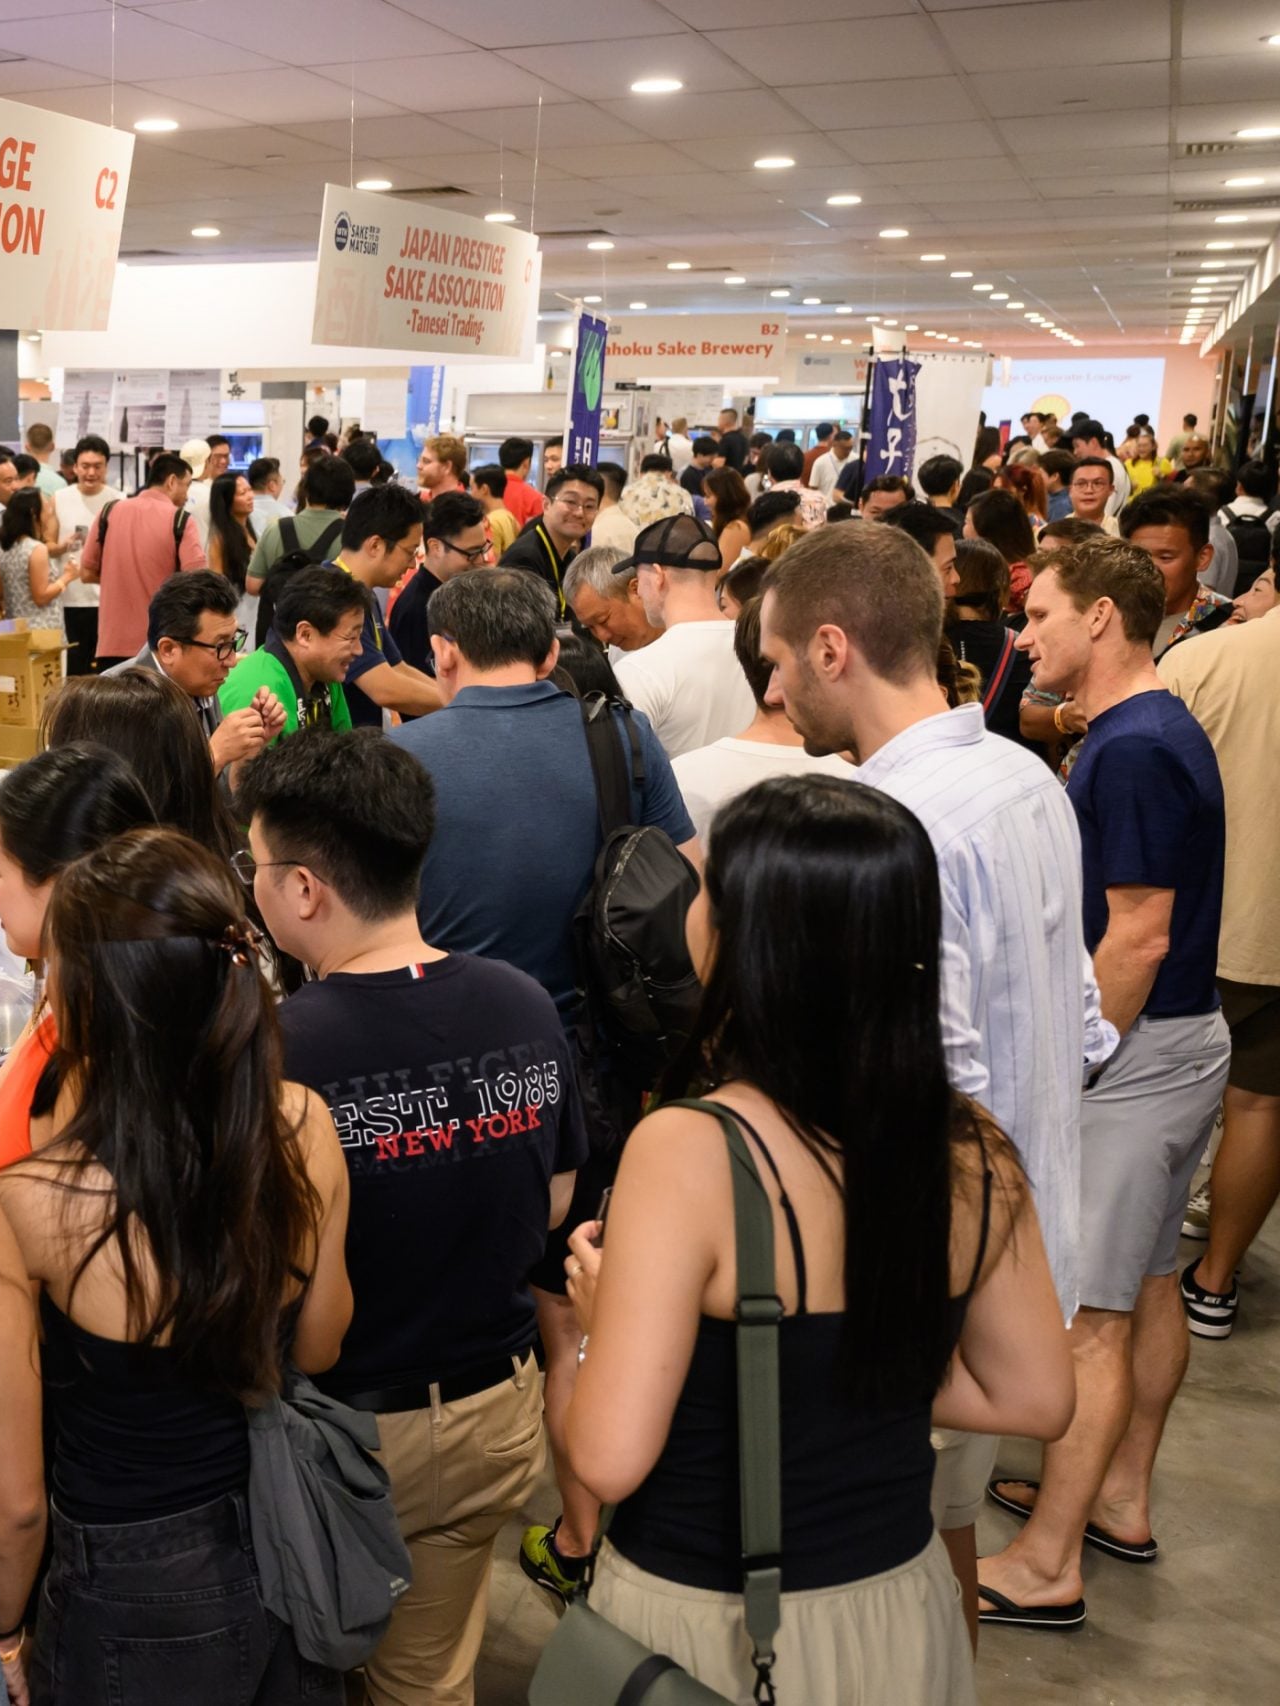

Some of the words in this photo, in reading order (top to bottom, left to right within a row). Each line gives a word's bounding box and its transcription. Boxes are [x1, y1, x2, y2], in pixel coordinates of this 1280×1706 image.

[94, 166, 119, 210] C2
[399, 225, 451, 266] JAPAN
[451, 238, 506, 276] PRESTIGE
[383, 264, 426, 301] SAKE
[427, 272, 506, 313] ASSOCIATION
[406, 308, 450, 336] -Tanesei
[452, 311, 485, 346] Trading-
[605, 341, 652, 356] ahoku
[657, 341, 696, 356] Sake
[701, 341, 774, 358] Brewery
[761, 323, 780, 336] B2
[328, 1085, 461, 1149] EST.
[471, 1060, 561, 1123] 1985
[376, 1124, 454, 1161] NEW
[466, 1103, 542, 1143] YORK
